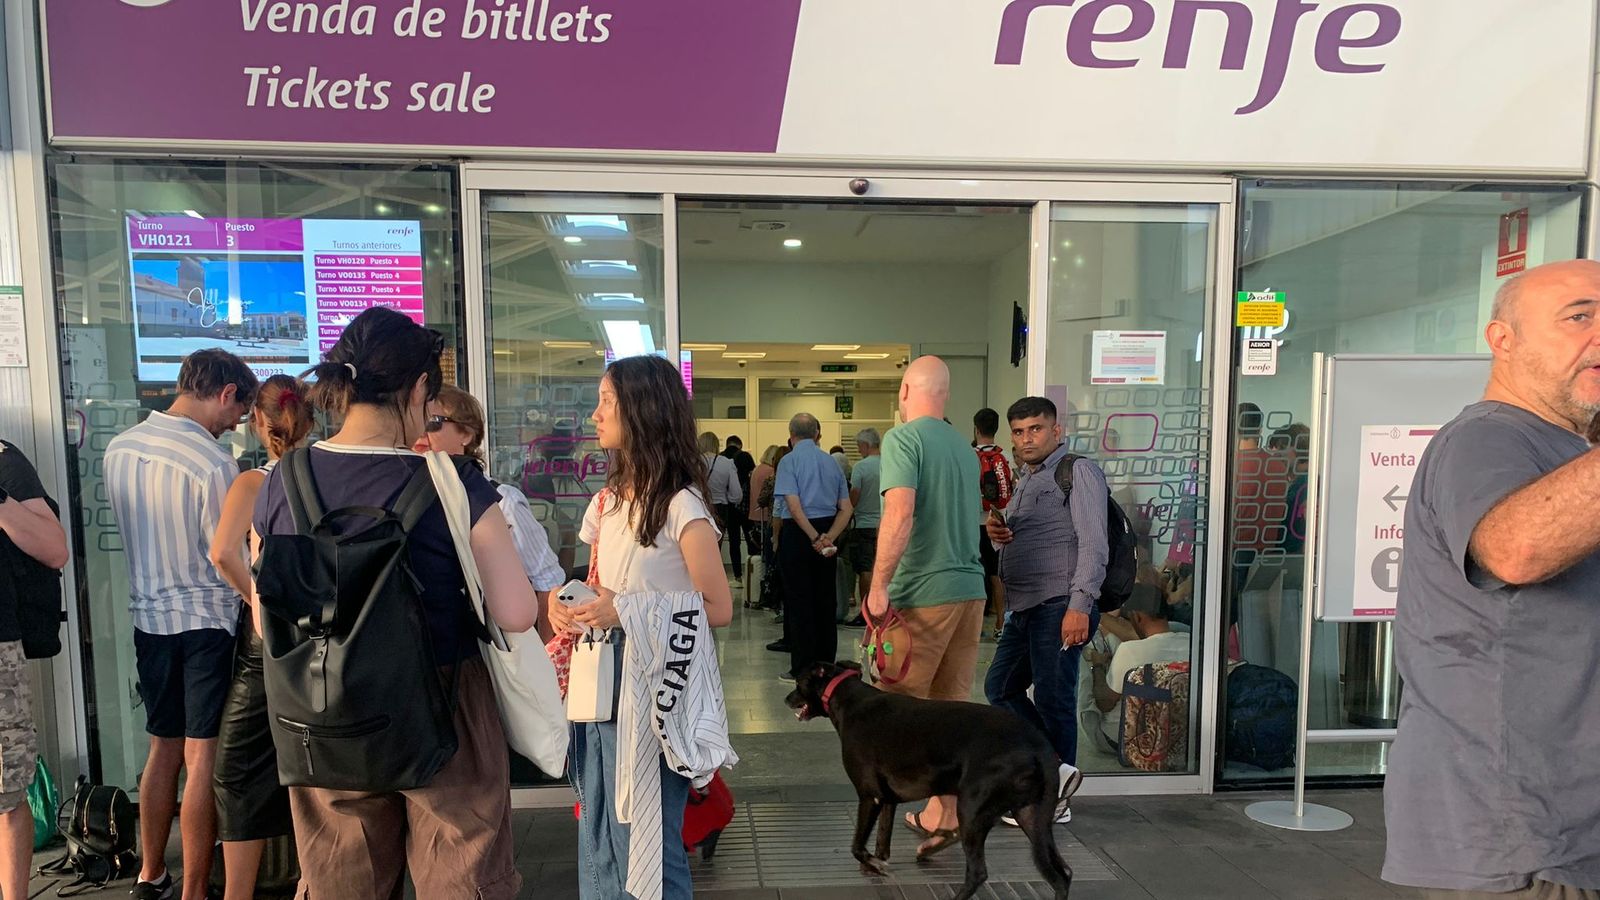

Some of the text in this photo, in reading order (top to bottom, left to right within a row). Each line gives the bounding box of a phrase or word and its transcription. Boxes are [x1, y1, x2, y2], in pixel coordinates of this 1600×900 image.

[239, 0, 613, 43] Venda de bitllets
[993, 0, 1402, 115] renfe
[243, 65, 496, 113] Tickets sale
[137, 221, 255, 232] Turno Puesto
[387, 226, 414, 237] renfe
[138, 234, 235, 247] VH0121 3
[332, 240, 401, 249] Turnos anteriores
[315, 257, 336, 265] Turno
[337, 257, 366, 265] VH0120
[370, 257, 393, 265] Puesto
[1497, 257, 1525, 272] EXTINTOR
[317, 271, 337, 279] Turno
[1248, 363, 1271, 372] renfe
[1370, 452, 1416, 467] Venta
[530, 452, 608, 484] renfe
[994, 461, 1008, 499] Supreme
